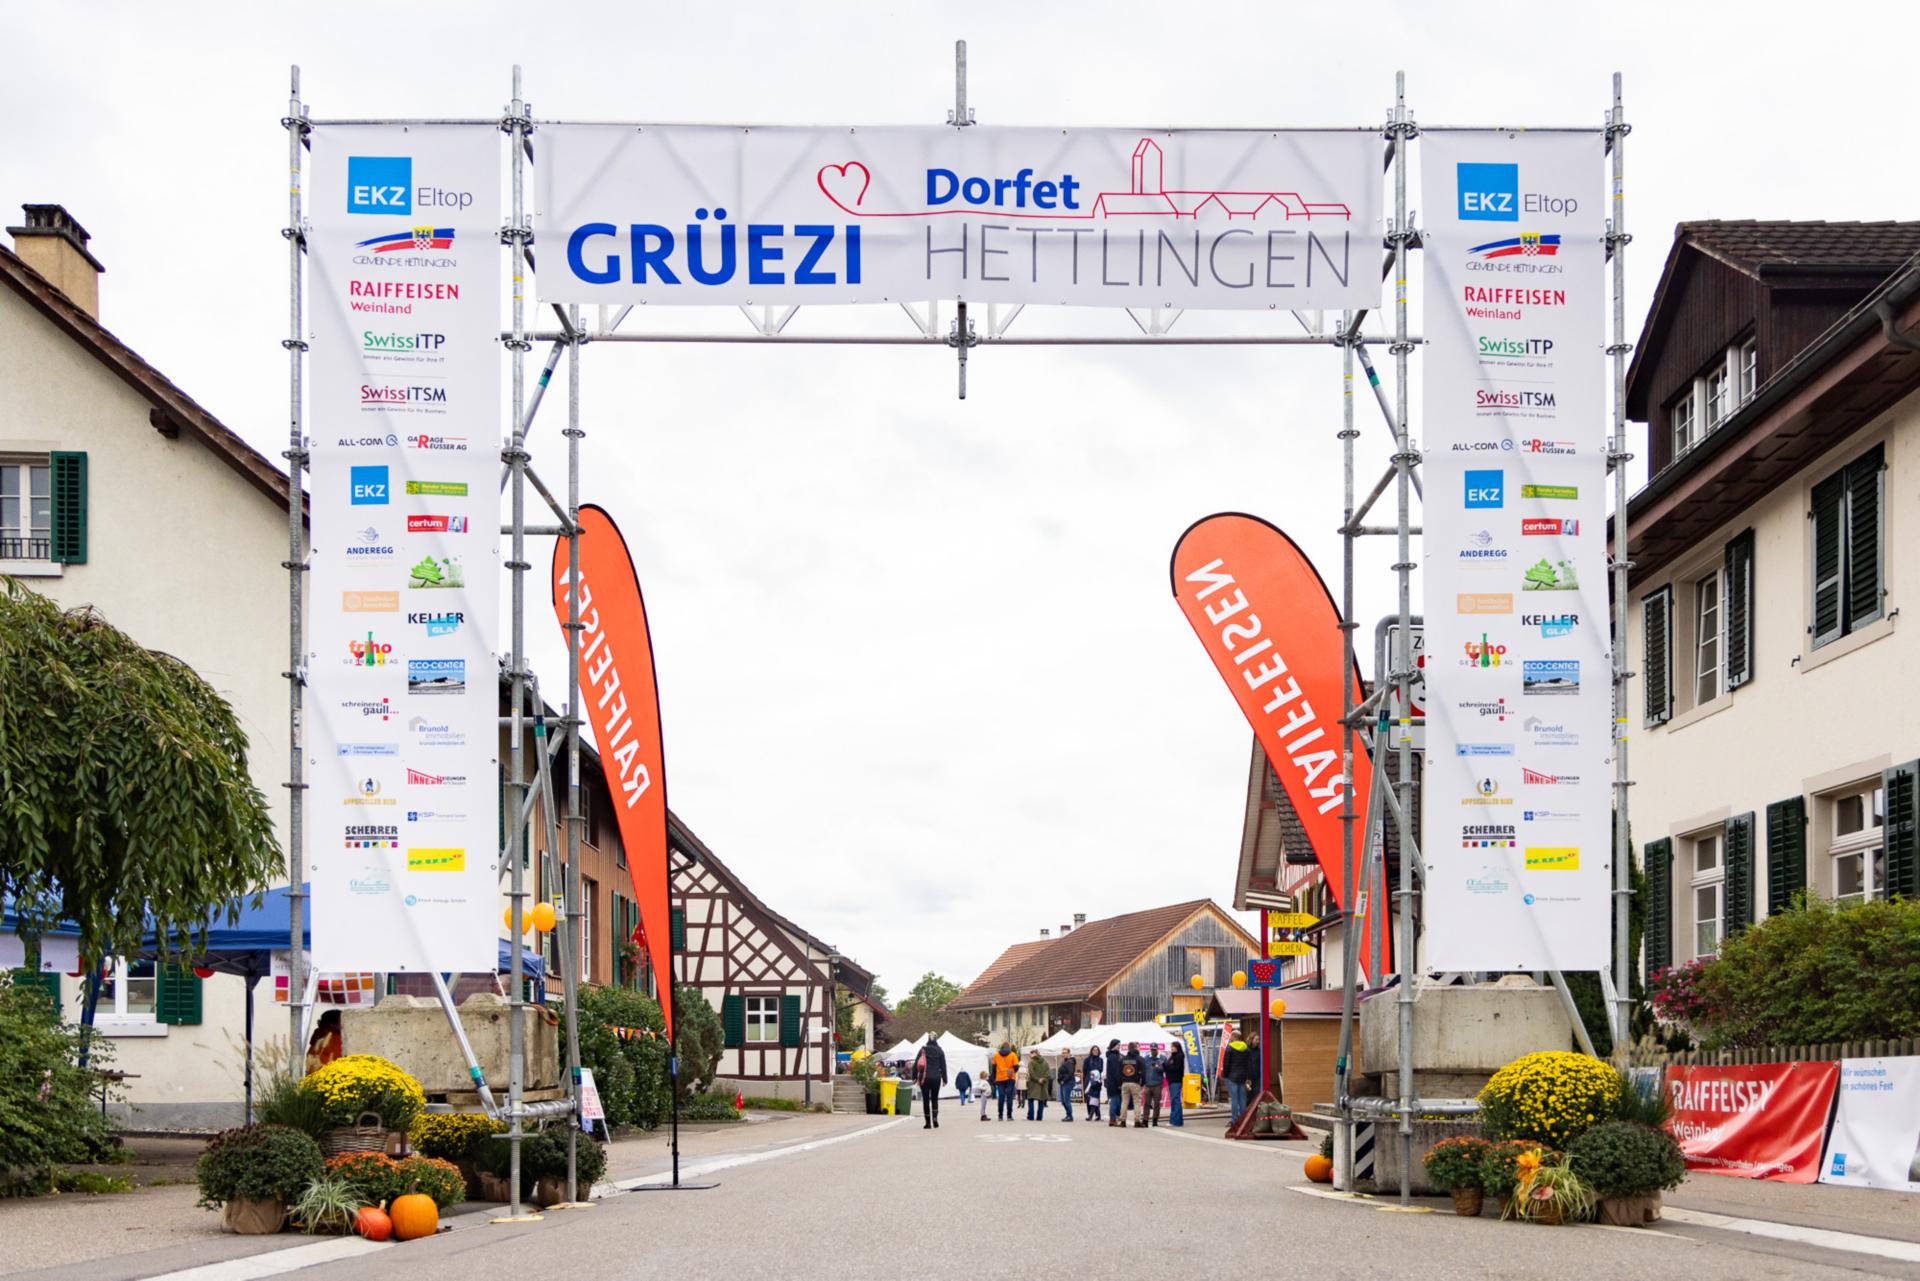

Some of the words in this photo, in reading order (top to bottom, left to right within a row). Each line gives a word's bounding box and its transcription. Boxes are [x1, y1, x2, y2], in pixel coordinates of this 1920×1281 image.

[926, 168, 1080, 210] Dorfet
[354, 185, 405, 206] EKZ
[418, 187, 473, 211] Eltop
[1464, 192, 1513, 212] EKZ
[1524, 194, 1578, 216] Eltop
[566, 207, 862, 286] GRÜEZI
[926, 223, 1350, 288] HETTLINGEN
[350, 280, 459, 299] RAIFFEISEN
[1464, 286, 1565, 305] RAIFFEISEN
[351, 301, 412, 314] Weinland
[1466, 307, 1521, 320] Weinland
[338, 438, 383, 446] ALL-COM
[1452, 442, 1498, 451] ALL-COM
[354, 484, 385, 497] EKZ
[1468, 488, 1500, 501] EKZ
[409, 518, 443, 528] certum
[1523, 522, 1557, 531] certum
[346, 547, 394, 555] ANDEREGG
[1460, 550, 1507, 558] ANDEREGG
[408, 612, 465, 624] KELLER
[1522, 614, 1579, 626] KELLER
[345, 825, 398, 835] SCHERRER
[1462, 825, 1515, 834] SCHERRER
[1271, 914, 1304, 926] KAFFEE
[1880, 1080, 1894, 1091] Fest
[1672, 1080, 1775, 1112] RAIFFEISEN
